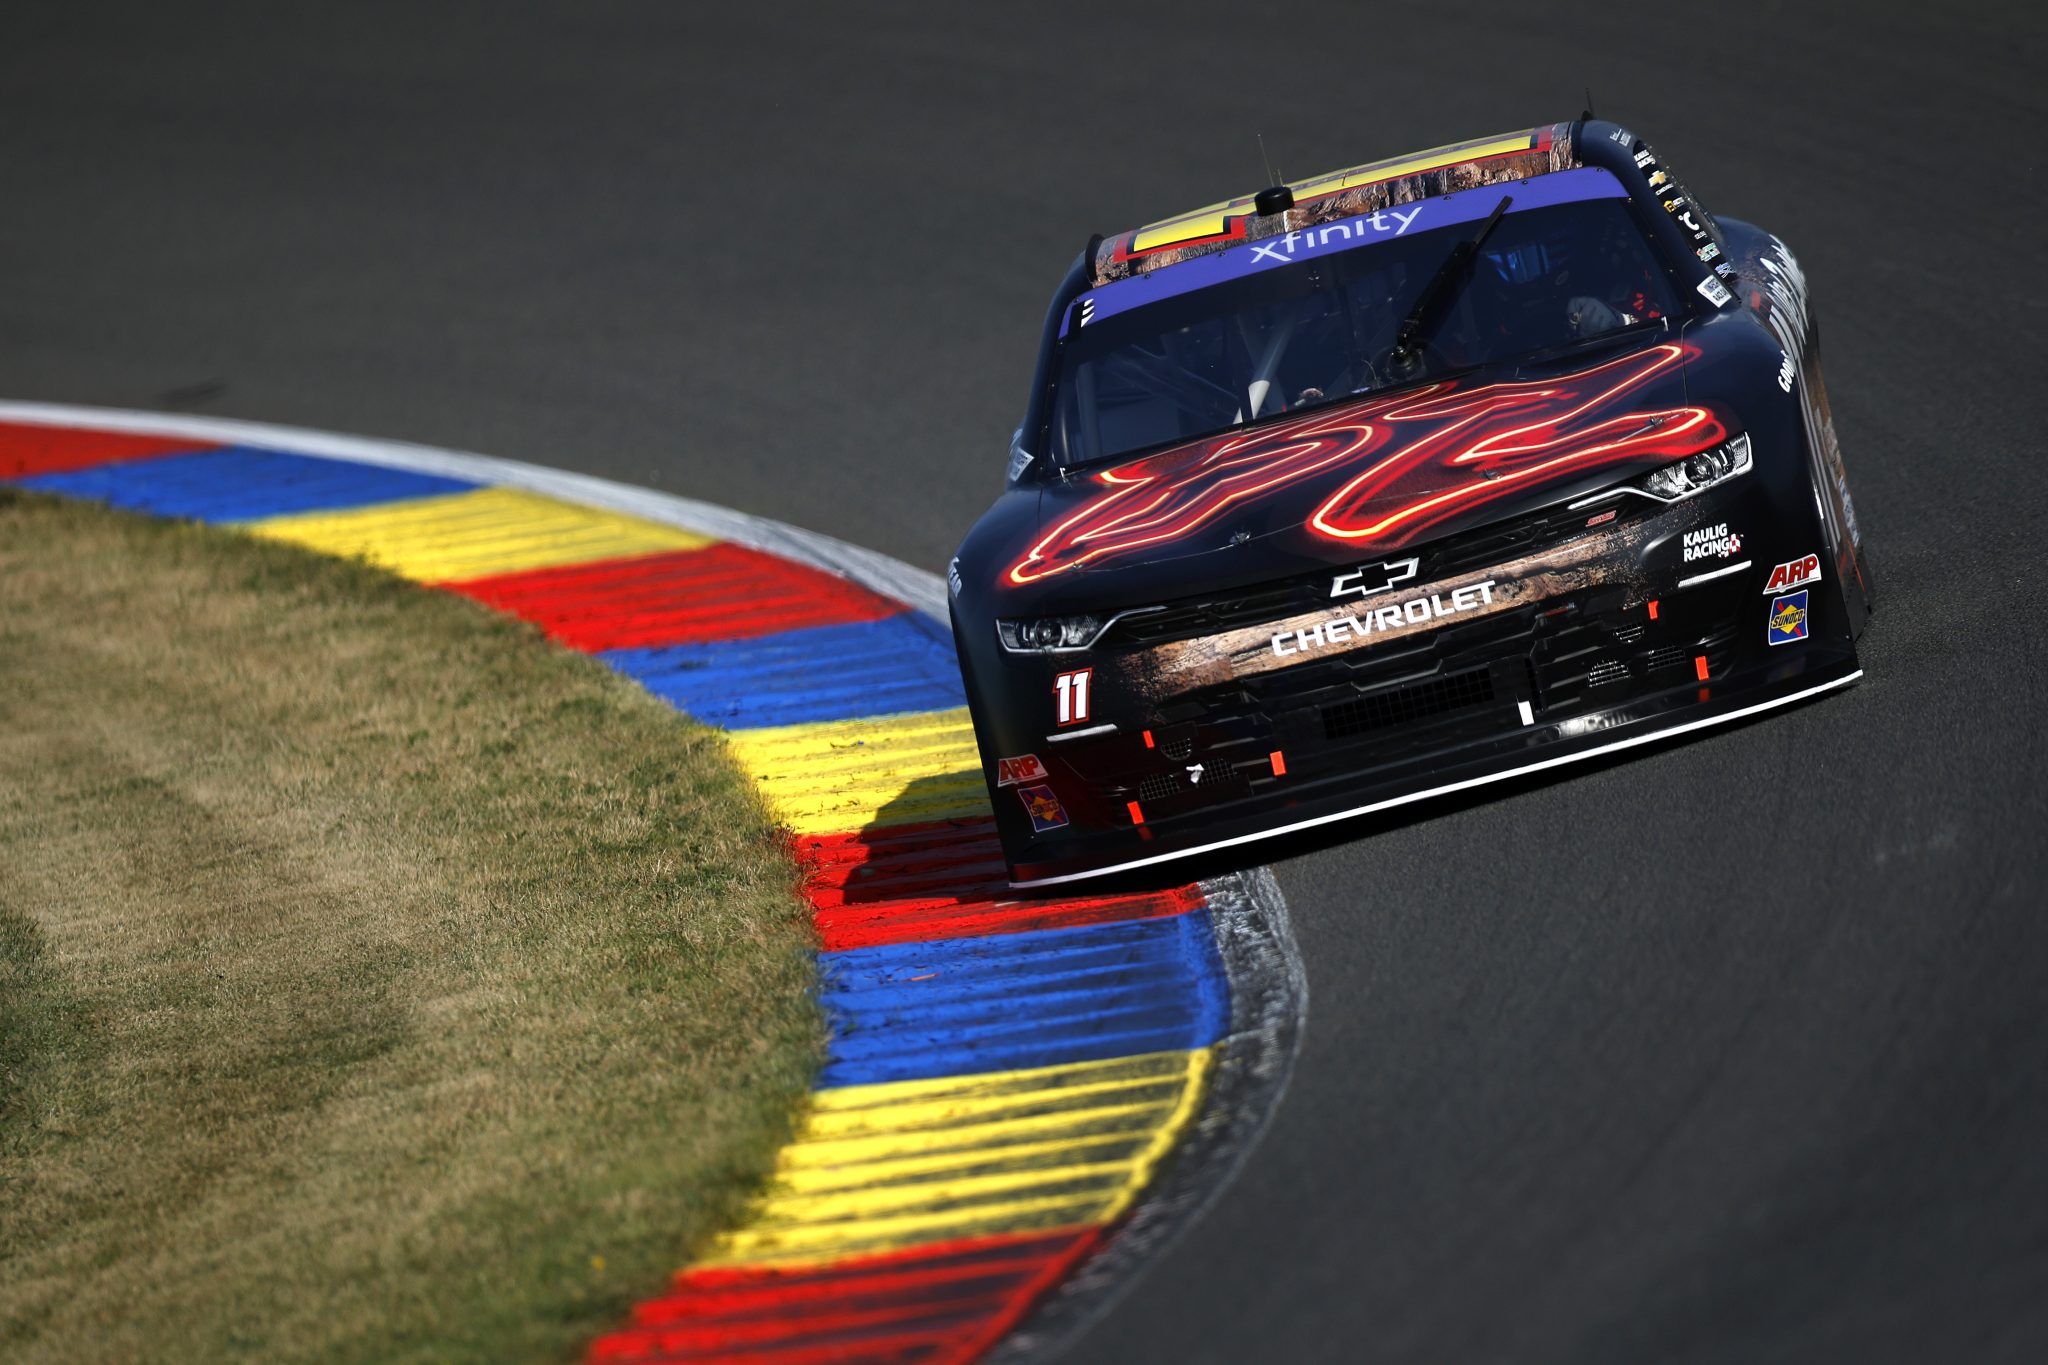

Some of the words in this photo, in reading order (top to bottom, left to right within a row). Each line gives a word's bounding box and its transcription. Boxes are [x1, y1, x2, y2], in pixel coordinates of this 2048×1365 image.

[1250, 207, 1423, 264] xfinity
[1683, 522, 1728, 548] KAULIG
[1683, 536, 1730, 562] RACING
[1767, 555, 1818, 589] ARP
[1271, 580, 1496, 657] CHEVROLET
[1772, 609, 1804, 628] SUNOCO
[1053, 668, 1092, 726] 11
[1000, 754, 1040, 782] ARP
